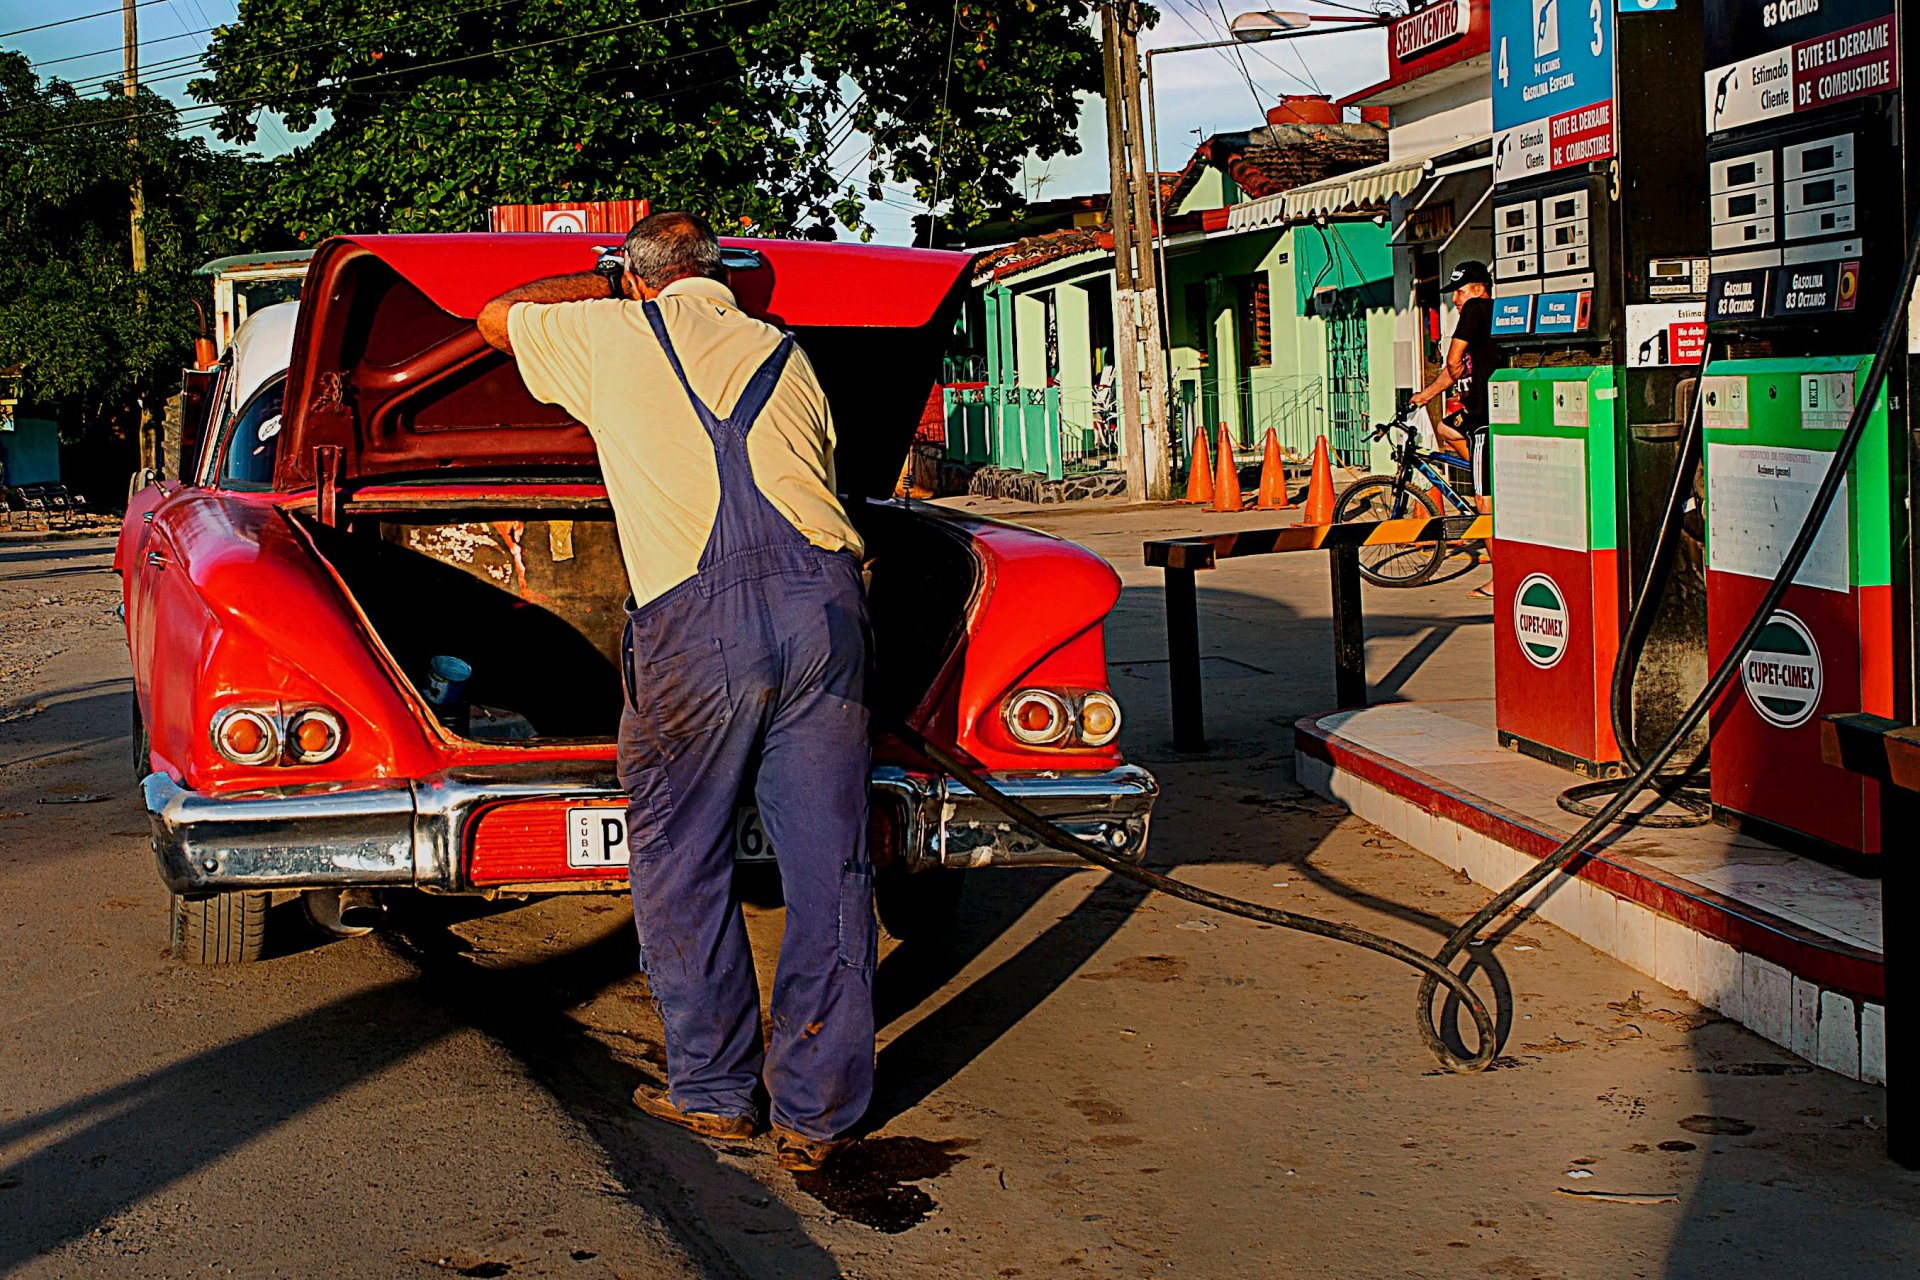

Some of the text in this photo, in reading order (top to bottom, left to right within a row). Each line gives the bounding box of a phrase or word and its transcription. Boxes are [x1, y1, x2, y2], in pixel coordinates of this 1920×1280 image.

[1397, 0, 1458, 57] SERVICENTRO
[1589, 0, 1603, 56] 3
[1763, 2, 1777, 28] 83
[1498, 36, 1509, 88] 4
[1798, 23, 1889, 71] EVITE EL DERRAME
[1752, 58, 1788, 86] Estimado
[1799, 60, 1890, 106] DE COMBUSTIBLE
[1761, 89, 1789, 110] Cliente
[1553, 105, 1610, 138] EVITE EL DERRAME
[1520, 129, 1544, 150] Estimado
[1554, 134, 1610, 166] DE COMBUSTIBLE
[1526, 153, 1545, 170] Cliente
[1609, 159, 1620, 201] 3
[1717, 298, 1727, 314] 83
[1785, 293, 1796, 309] 83
[1519, 613, 1563, 639] CUPET-CIMEX
[1749, 660, 1815, 691] CUPET-CIMEX
[580, 817, 589, 858] CUBA
[601, 818, 624, 860] P
